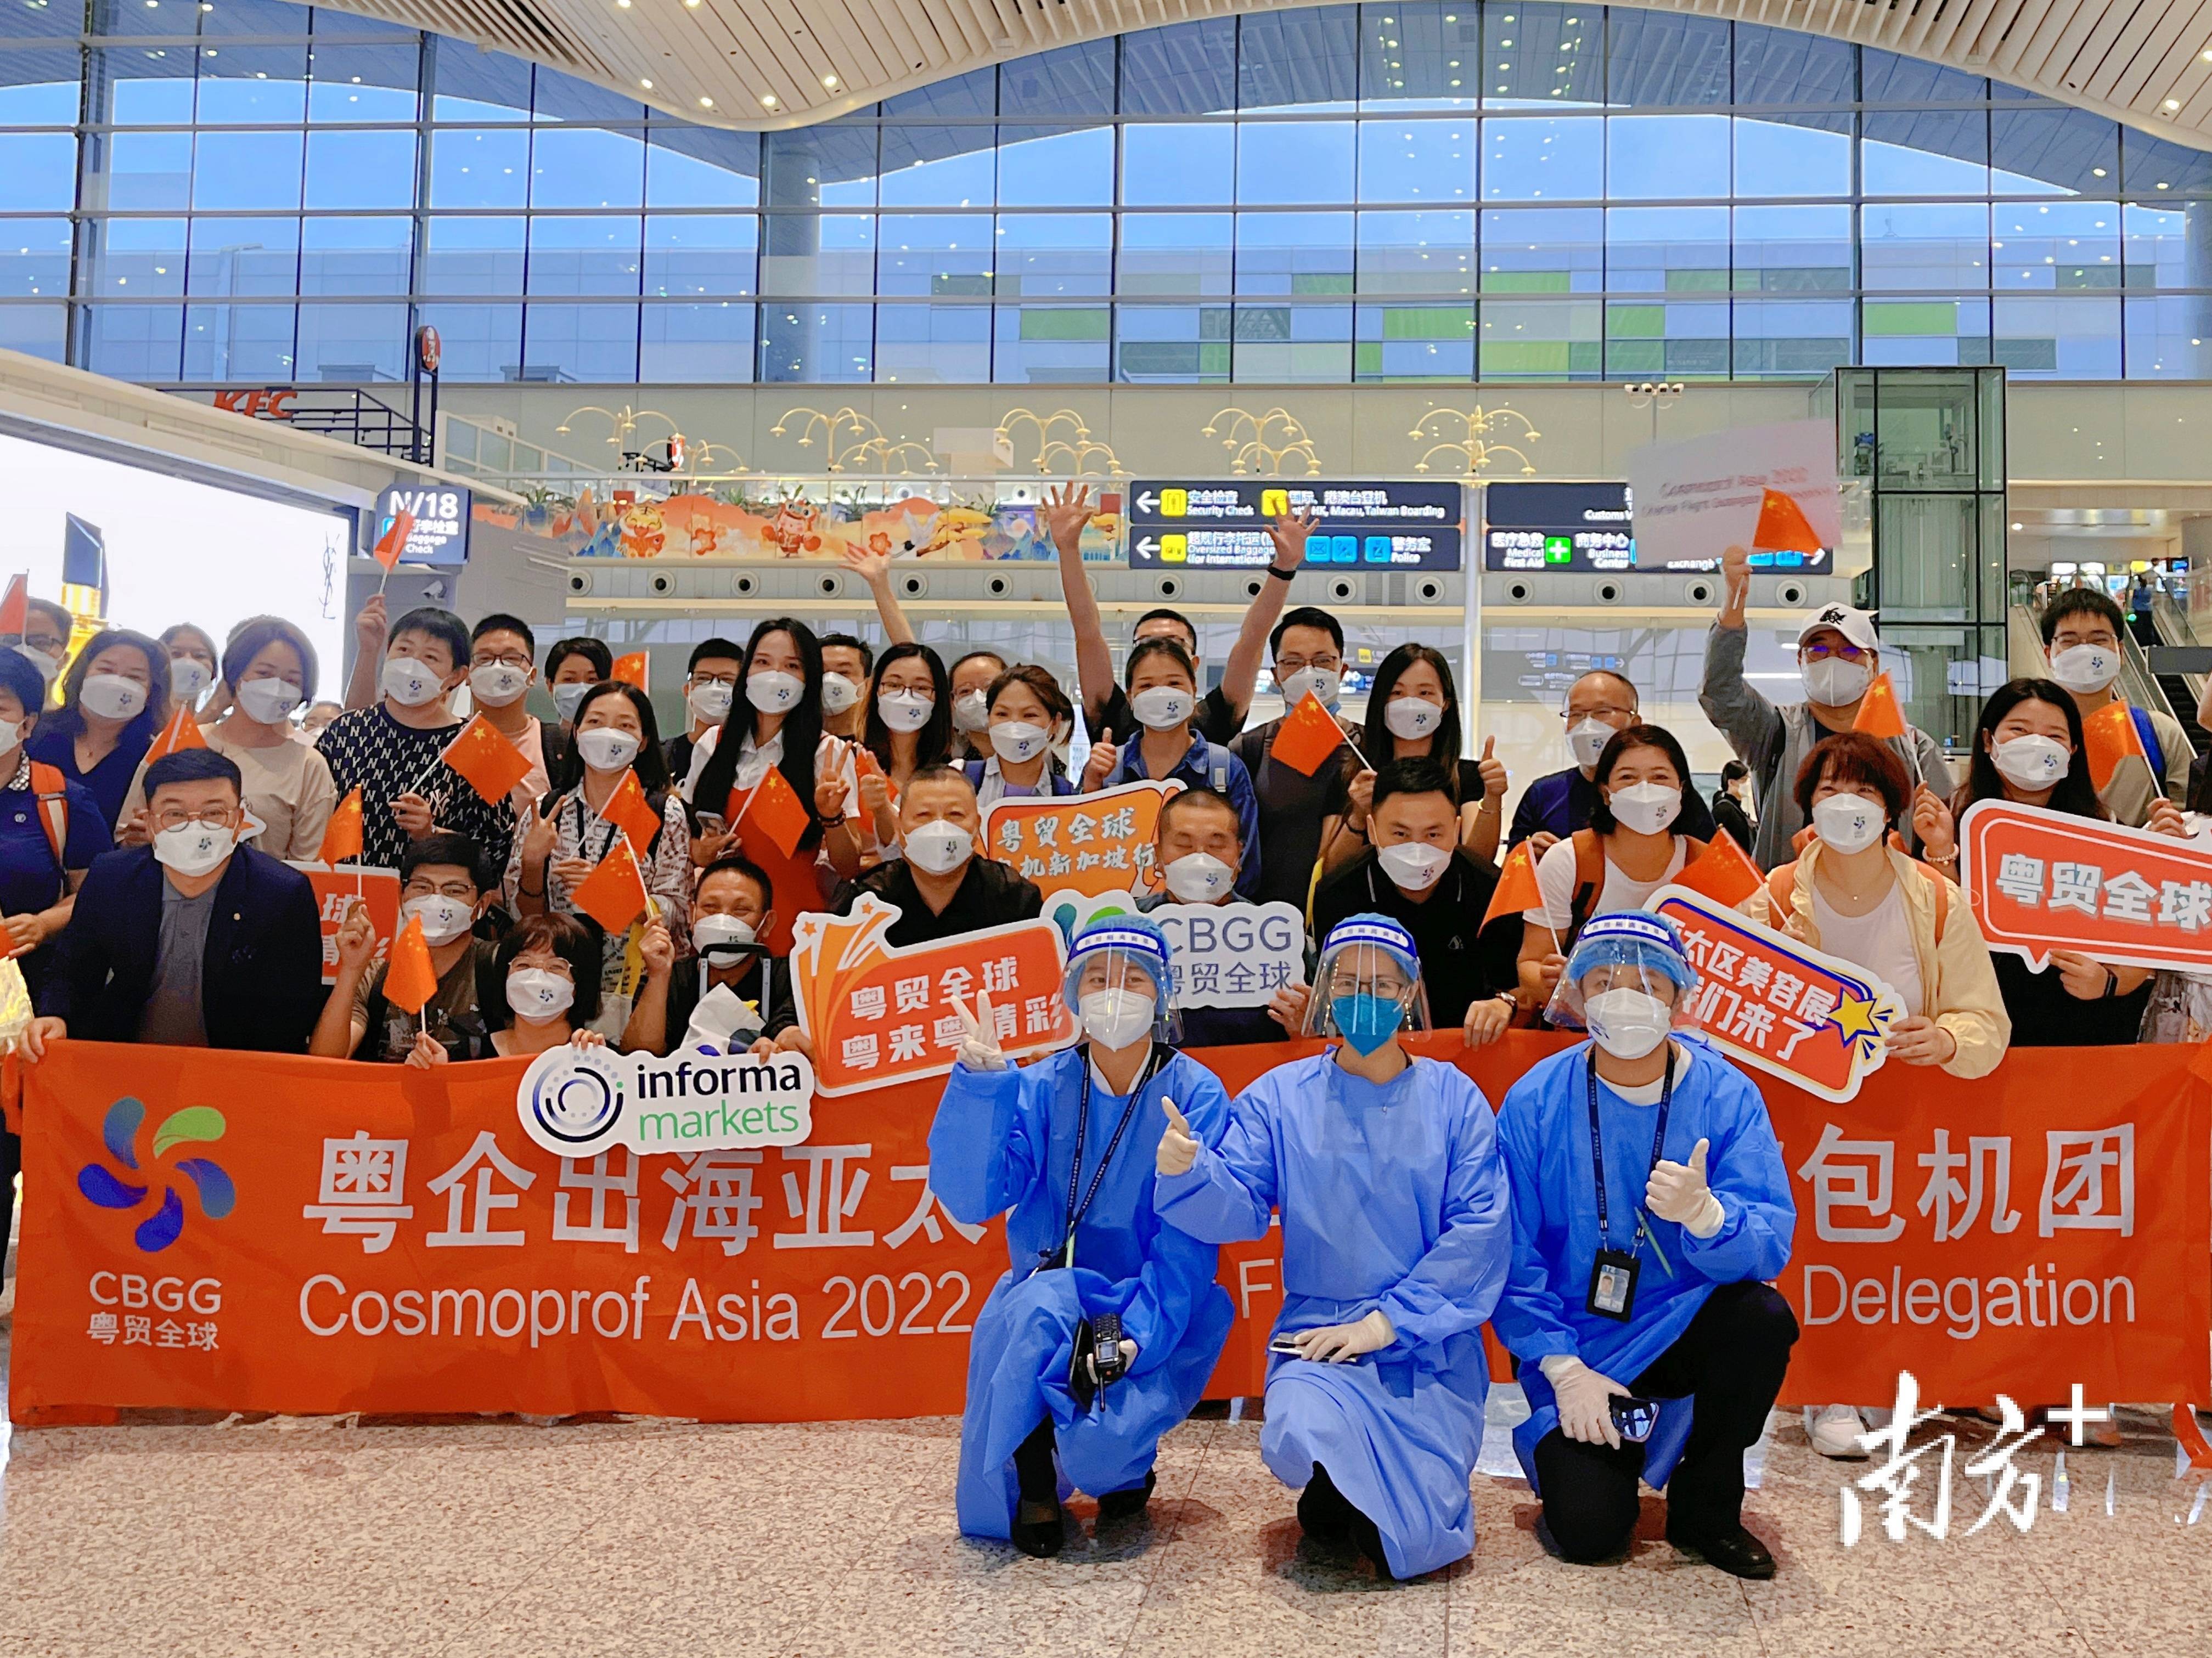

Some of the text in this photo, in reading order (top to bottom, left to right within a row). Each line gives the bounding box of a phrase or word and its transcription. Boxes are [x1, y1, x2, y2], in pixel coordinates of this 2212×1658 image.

[214, 390, 297, 418] KFC
[389, 490, 458, 518] N/18
[1187, 489, 1239, 505] 安全检查
[1187, 505, 1254, 517] Security Check
[1365, 505, 1399, 516] Taiwan
[1400, 505, 1445, 518] Boarding
[1584, 509, 1624, 520] Customs
[405, 543, 434, 554] Check
[1187, 545, 1276, 556] Oversized Baggage
[1491, 532, 1546, 548] 医疗急救
[1574, 532, 1629, 549] 商务中心
[1186, 555, 1205, 564] (for
[1391, 552, 1421, 563] Police
[1504, 557, 1546, 568] First Aid
[1506, 548, 1545, 559] Medical
[1587, 548, 1629, 559] Business
[1593, 557, 1630, 569] Center
[997, 807, 1136, 853] 粤贸全球
[996, 842, 1156, 879] 机新加坡行
[1995, 853, 2212, 933] 粤贸全球
[849, 956, 1020, 1021] 粤贸全球
[637, 1061, 802, 1099] informa
[639, 1099, 800, 1141] markets
[303, 1130, 988, 1256] 粤企出海亚太
[1797, 1122, 2135, 1243] 包机团
[89, 1271, 222, 1315] CBGG
[1804, 1262, 2135, 1340] Delegation
[299, 1270, 972, 1349] Cosmoprof Asia 2022
[86, 1311, 219, 1351] 粤贸全球
